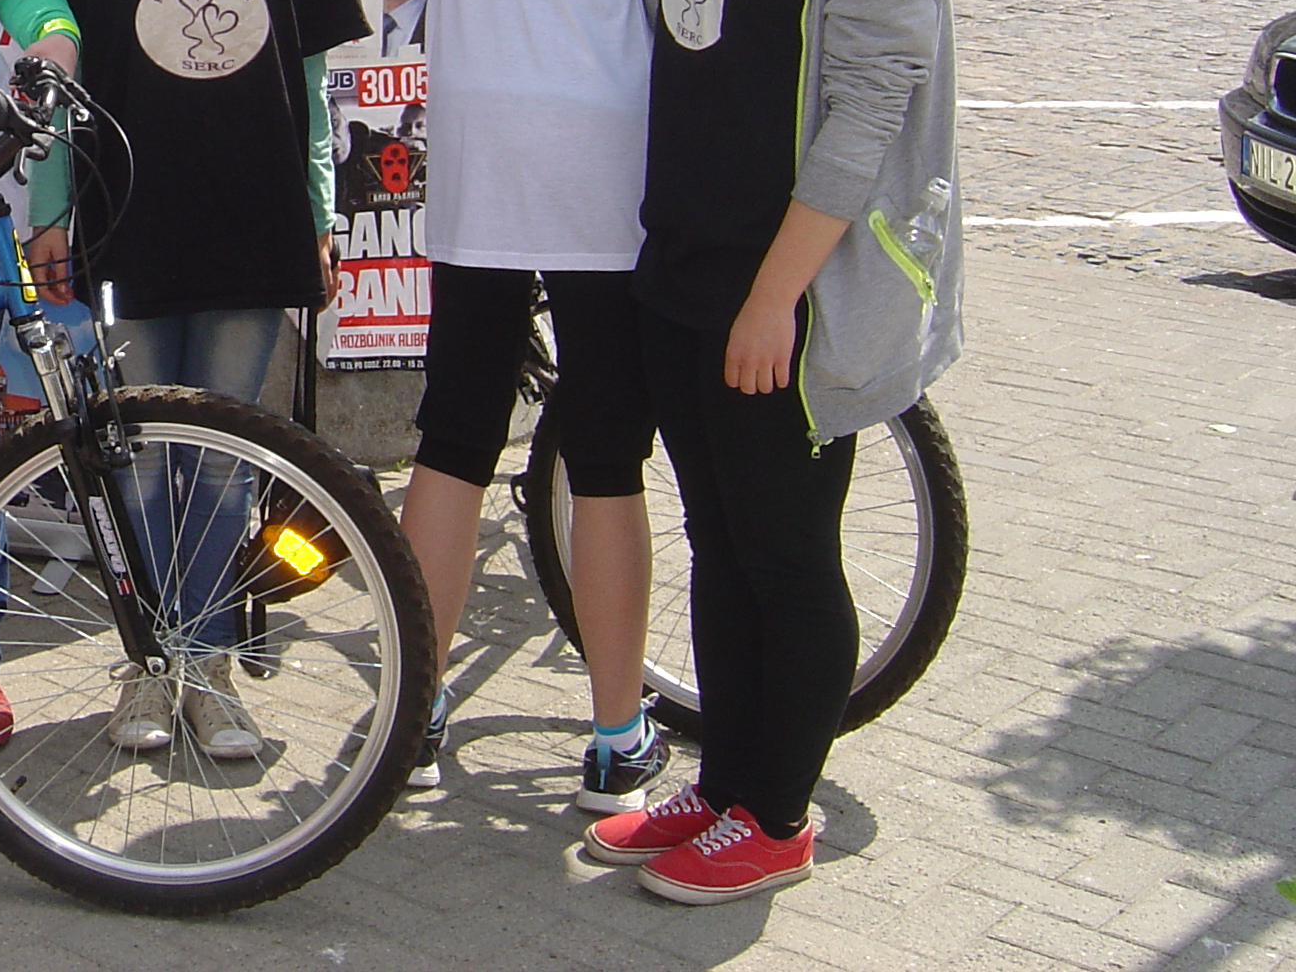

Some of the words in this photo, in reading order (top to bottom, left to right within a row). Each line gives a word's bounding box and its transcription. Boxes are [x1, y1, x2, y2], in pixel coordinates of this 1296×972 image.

[181, 59, 236, 72] SERC
[1251, 141, 1280, 185] NIL
[340, 330, 396, 349] ROZBÓJNIK
